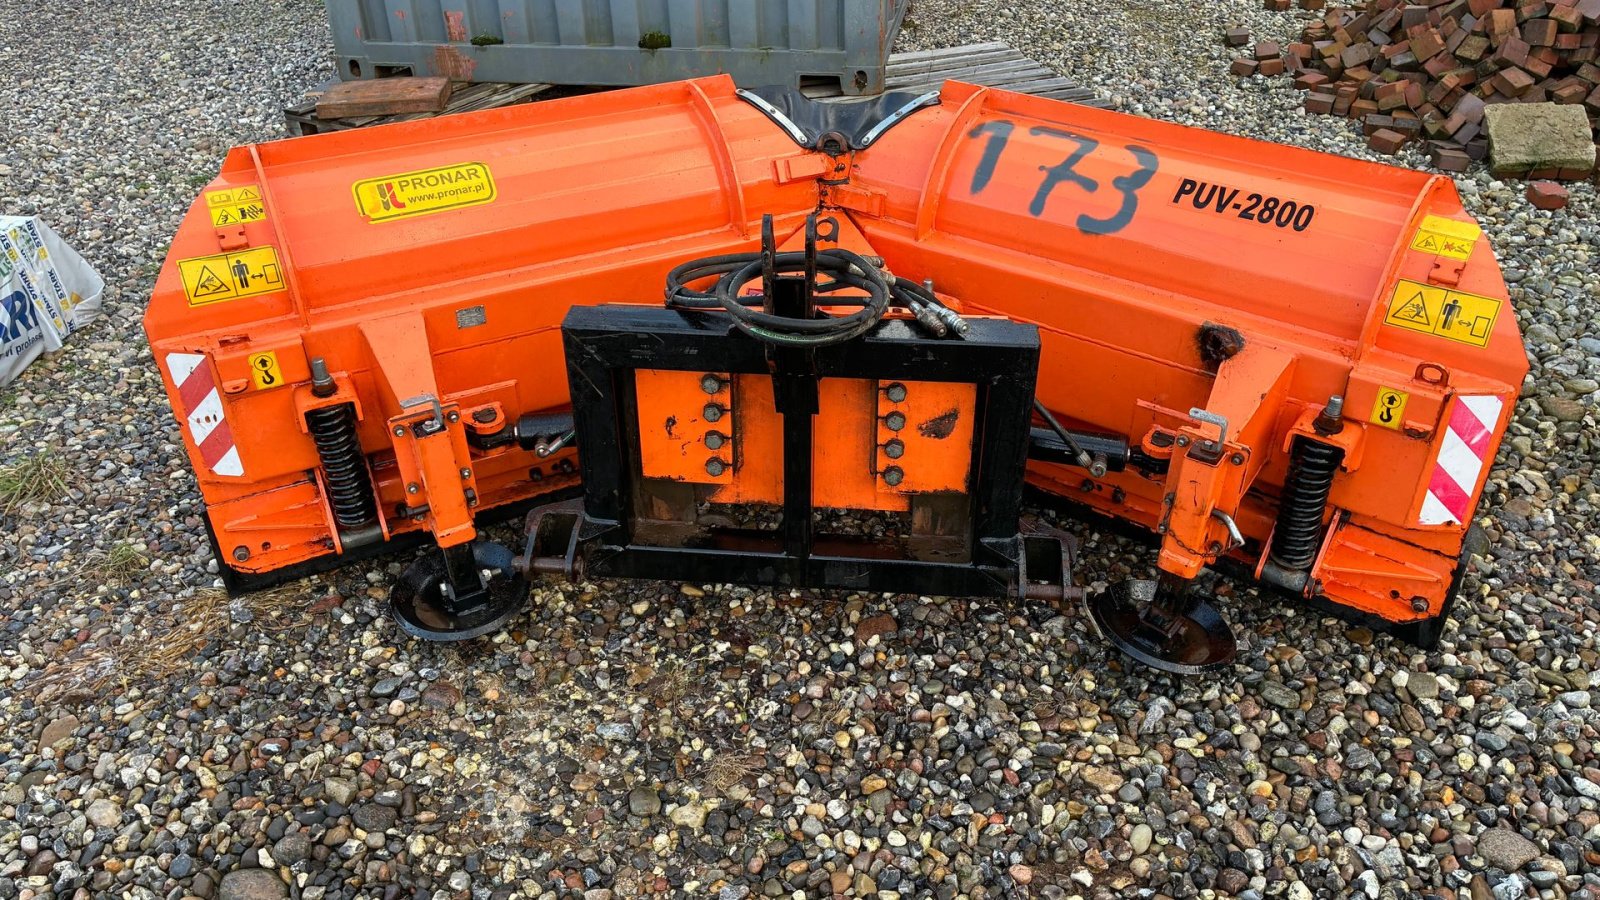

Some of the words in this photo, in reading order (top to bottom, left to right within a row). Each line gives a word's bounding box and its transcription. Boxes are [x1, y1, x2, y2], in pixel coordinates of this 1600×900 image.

[398, 168, 481, 192] PRONAR
[408, 182, 485, 204] www.pronar.pl
[968, 119, 1159, 234] 173
[1172, 178, 1315, 232] PUV-2800
[47, 267, 66, 300] STARK
